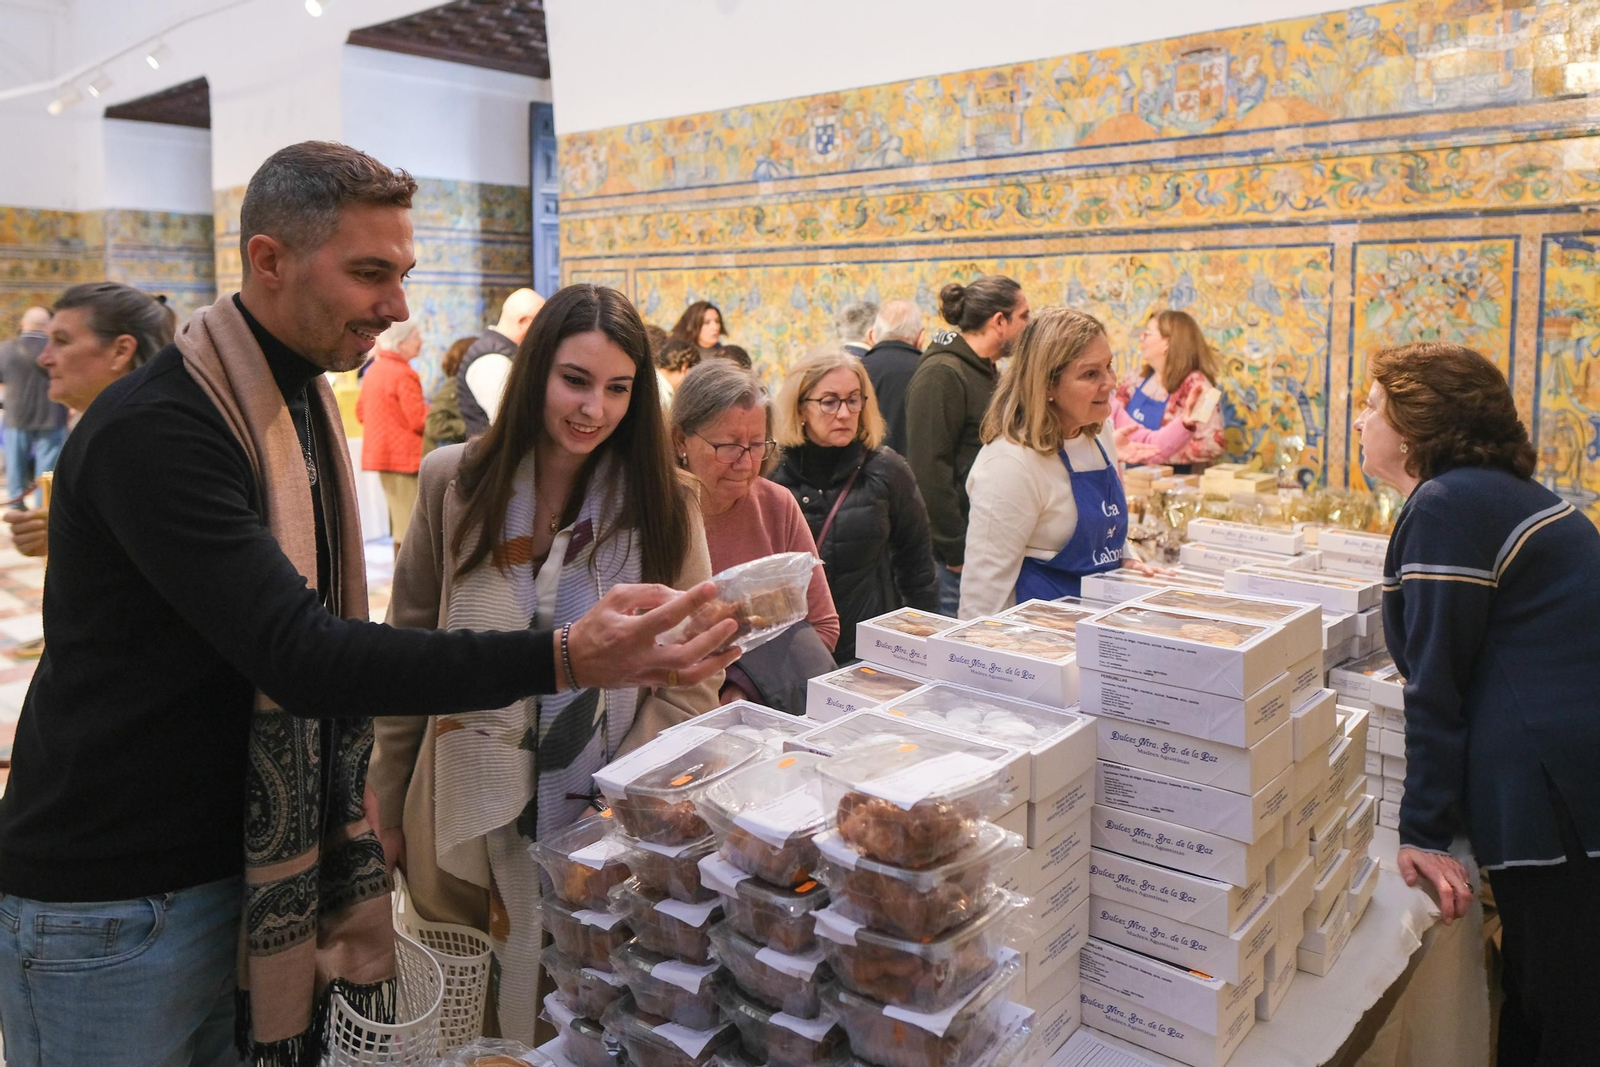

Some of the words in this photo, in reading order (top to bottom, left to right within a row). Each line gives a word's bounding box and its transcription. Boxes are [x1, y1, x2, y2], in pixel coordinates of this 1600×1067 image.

[1092, 546, 1122, 566] Labo
[875, 639, 893, 650] Dulces
[948, 653, 970, 665] Dulces
[968, 658, 987, 670] Ntra.
[1005, 667, 1013, 675] de
[1014, 668, 1020, 677] la
[1021, 669, 1036, 680] Paz
[1110, 730, 1136, 744] Dulces
[1134, 737, 1159, 750] Ntra.
[1160, 742, 1178, 754] Sra.
[1181, 747, 1190, 757] de
[1191, 750, 1199, 759] la
[1200, 751, 1218, 763] Paz
[1105, 819, 1131, 834] Dulces
[1129, 827, 1154, 840] Ntra.
[1155, 833, 1173, 845] Sra.
[1176, 839, 1185, 848] de
[1187, 841, 1194, 850] la
[1195, 843, 1213, 855] Paz
[1089, 865, 1115, 879] Dulces
[1113, 873, 1138, 886] Ntra.
[1139, 879, 1157, 892] Sra.
[1160, 886, 1169, 895] de
[1170, 888, 1178, 898] la
[1178, 891, 1197, 904] Paz
[1100, 910, 1126, 925] Dulces
[1123, 919, 1148, 933] Ntra.
[1150, 926, 1168, 940] Sra.
[1170, 934, 1179, 943] de
[1181, 936, 1188, 946] la
[1189, 939, 1207, 952] Paz
[1080, 993, 1105, 1009] Dulces
[1102, 1004, 1127, 1019] Ntra.
[1148, 1021, 1157, 1030] de
[1158, 1023, 1166, 1033] la
[1167, 1027, 1185, 1040] Paz
